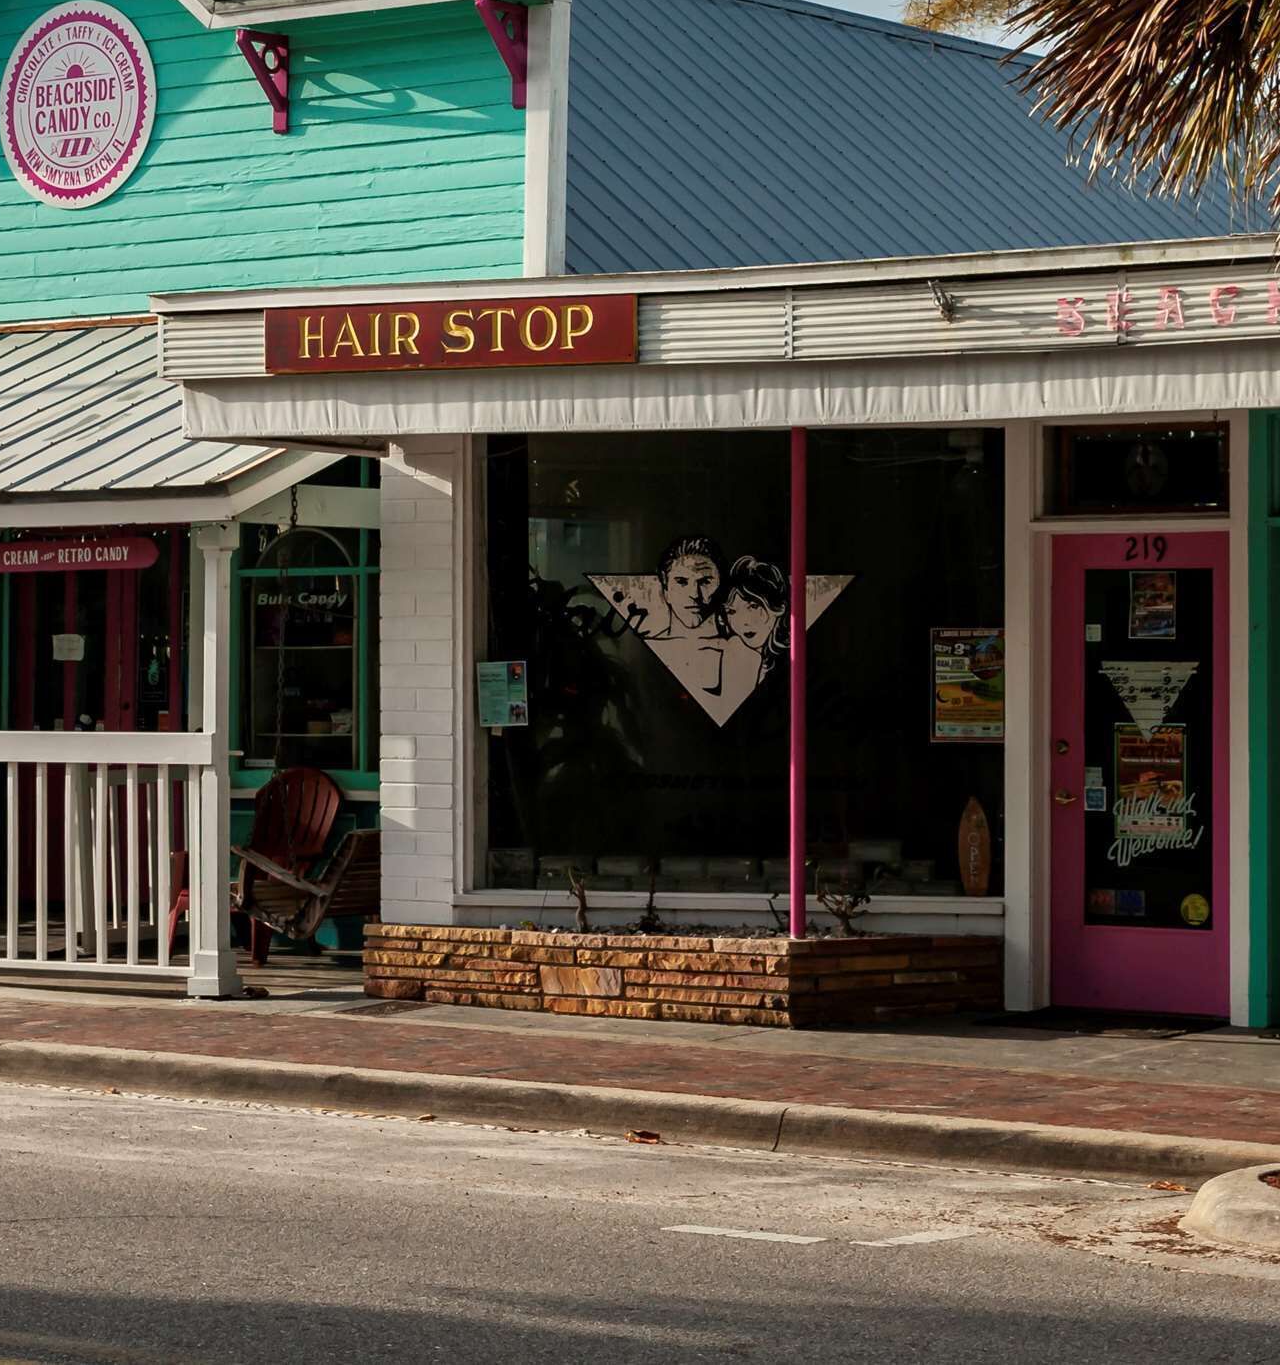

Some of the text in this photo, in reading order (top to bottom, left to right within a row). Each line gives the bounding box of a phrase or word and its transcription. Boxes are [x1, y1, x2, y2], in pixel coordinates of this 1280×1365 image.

[16, 25, 136, 103] CHOCOLATE TAFFY ICE CREAM
[35, 77, 117, 109] BEACHSIDE
[35, 105, 116, 135] CANDY CO.
[24, 147, 42, 173] NEW
[42, 165, 82, 186] SMYRNA
[113, 137, 127, 154] FL
[298, 303, 594, 359] HAIR STOP
[3, 549, 39, 566] CREAM
[57, 546, 92, 563] RETRO
[94, 545, 129, 562] CANDY
[1125, 535, 1167, 563] 219
[297, 590, 349, 608] Candy
[1112, 791, 1198, 825] Walk-ins
[1106, 825, 1204, 867] Welcome!
